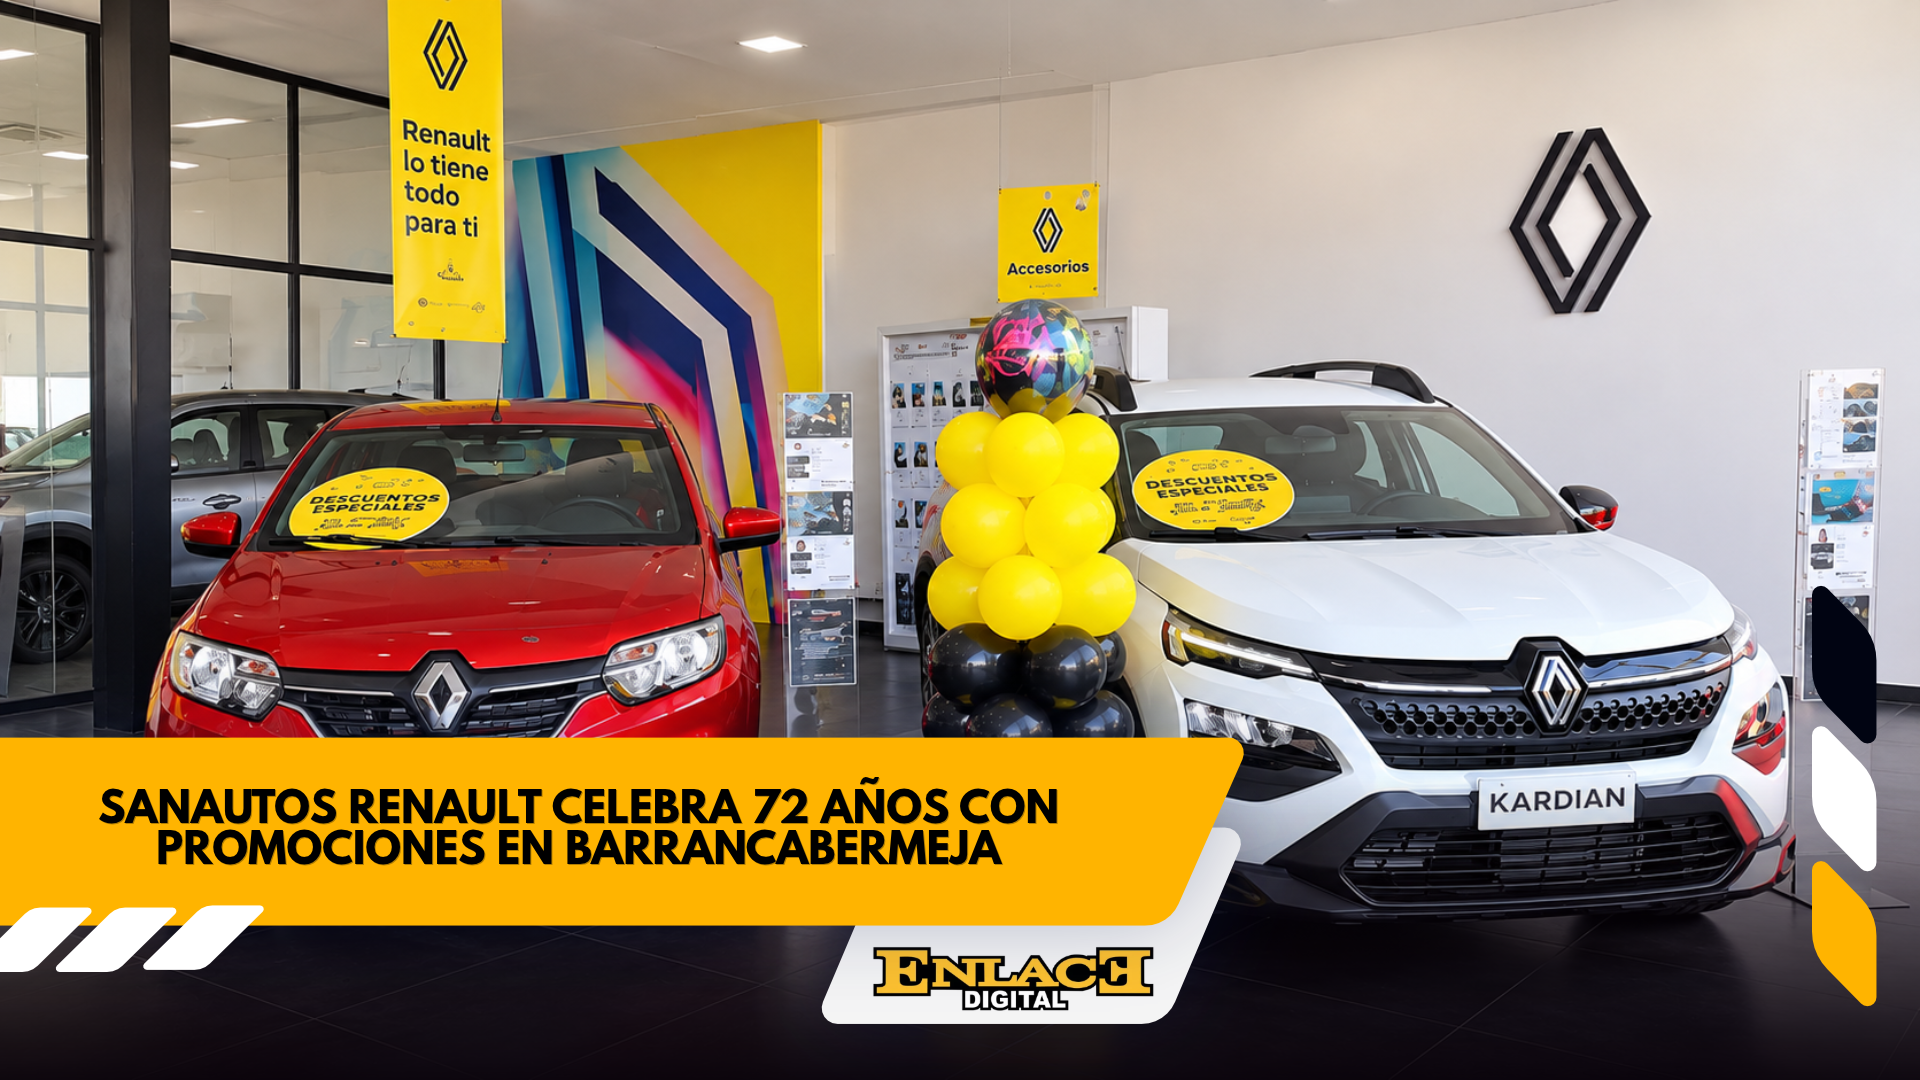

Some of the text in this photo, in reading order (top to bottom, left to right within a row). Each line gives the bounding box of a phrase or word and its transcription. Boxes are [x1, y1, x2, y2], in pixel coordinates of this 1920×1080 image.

[402, 119, 491, 153] Renault
[403, 149, 489, 181] lo tiene
[404, 180, 460, 206] todo
[405, 213, 478, 238] para ti
[1007, 259, 1090, 276] Accesorios
[1145, 472, 1278, 489] DESCUENTOS
[1156, 482, 1270, 499] ESPECIALES
[309, 494, 441, 505] DESCUENTOS
[312, 503, 426, 514] ESPECIALES
[1489, 786, 1627, 814] KARDIAN
